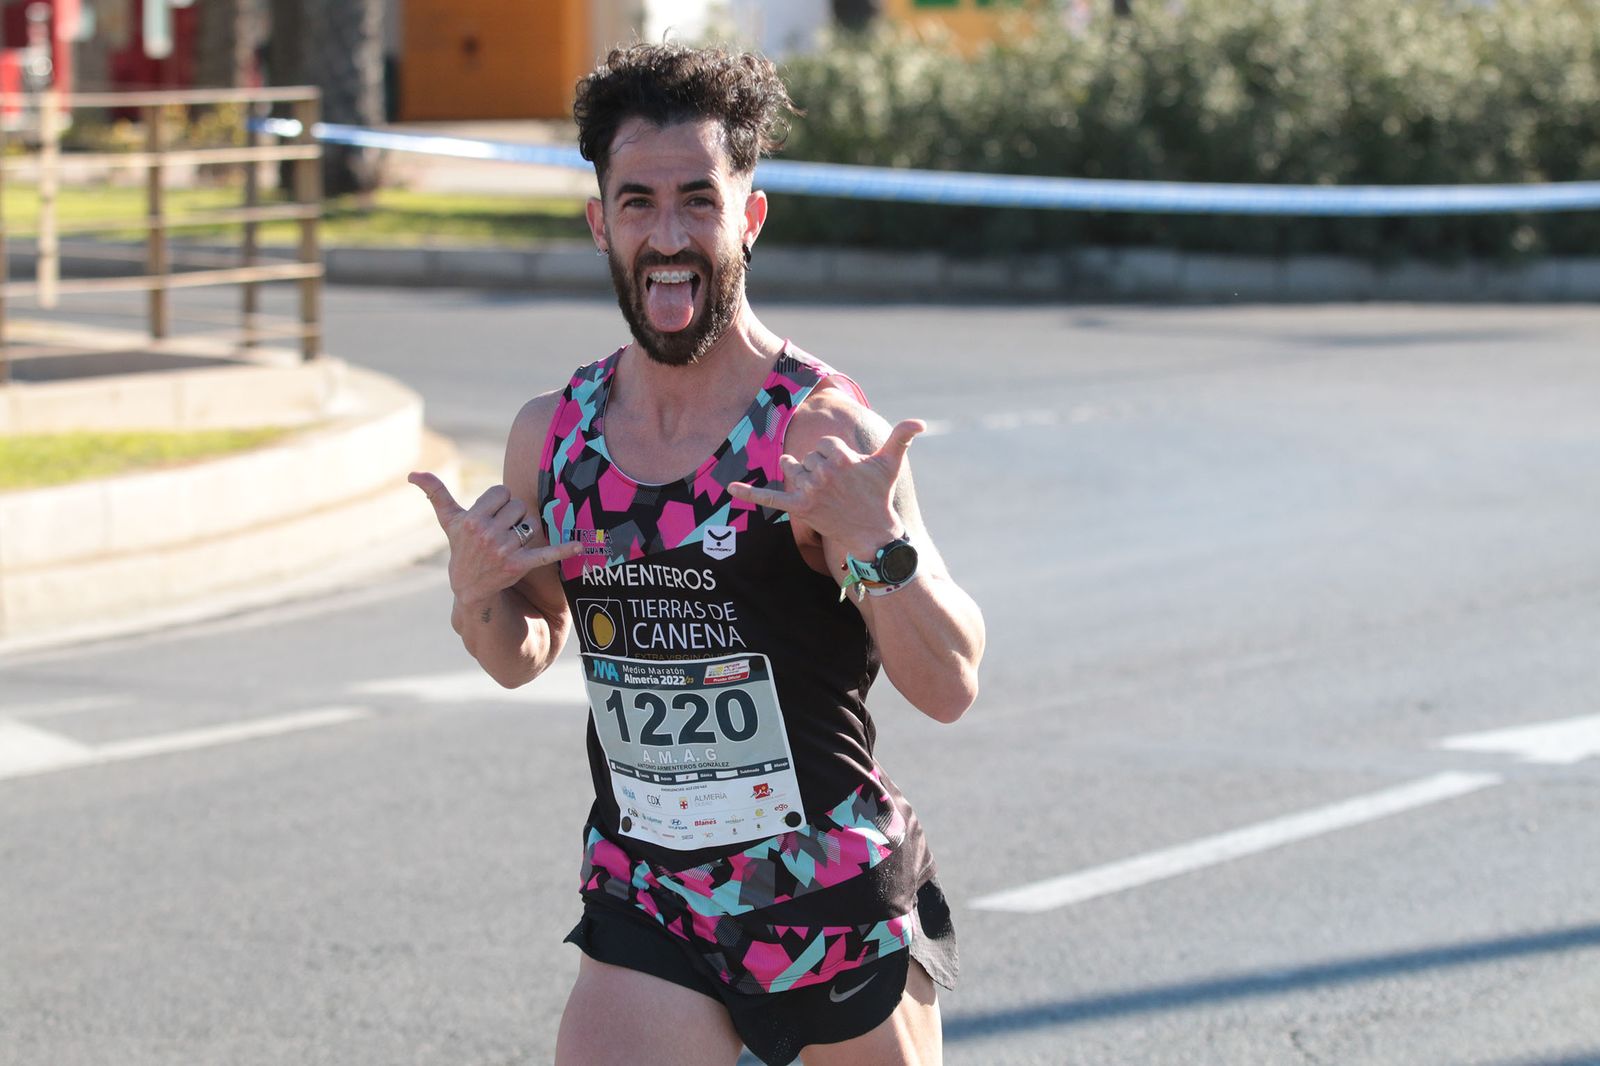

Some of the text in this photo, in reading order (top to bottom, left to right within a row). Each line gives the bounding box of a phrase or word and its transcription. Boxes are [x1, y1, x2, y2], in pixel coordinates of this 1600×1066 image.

[582, 564, 717, 591] ARMENTEROS
[627, 599, 738, 621] TIERRAS DE
[632, 622, 748, 649] CANENA
[622, 664, 685, 675] Medio Maratón
[605, 689, 759, 746] 1220
[637, 762, 657, 770] ANTONIO
[657, 762, 697, 771] ARMENTEROS
